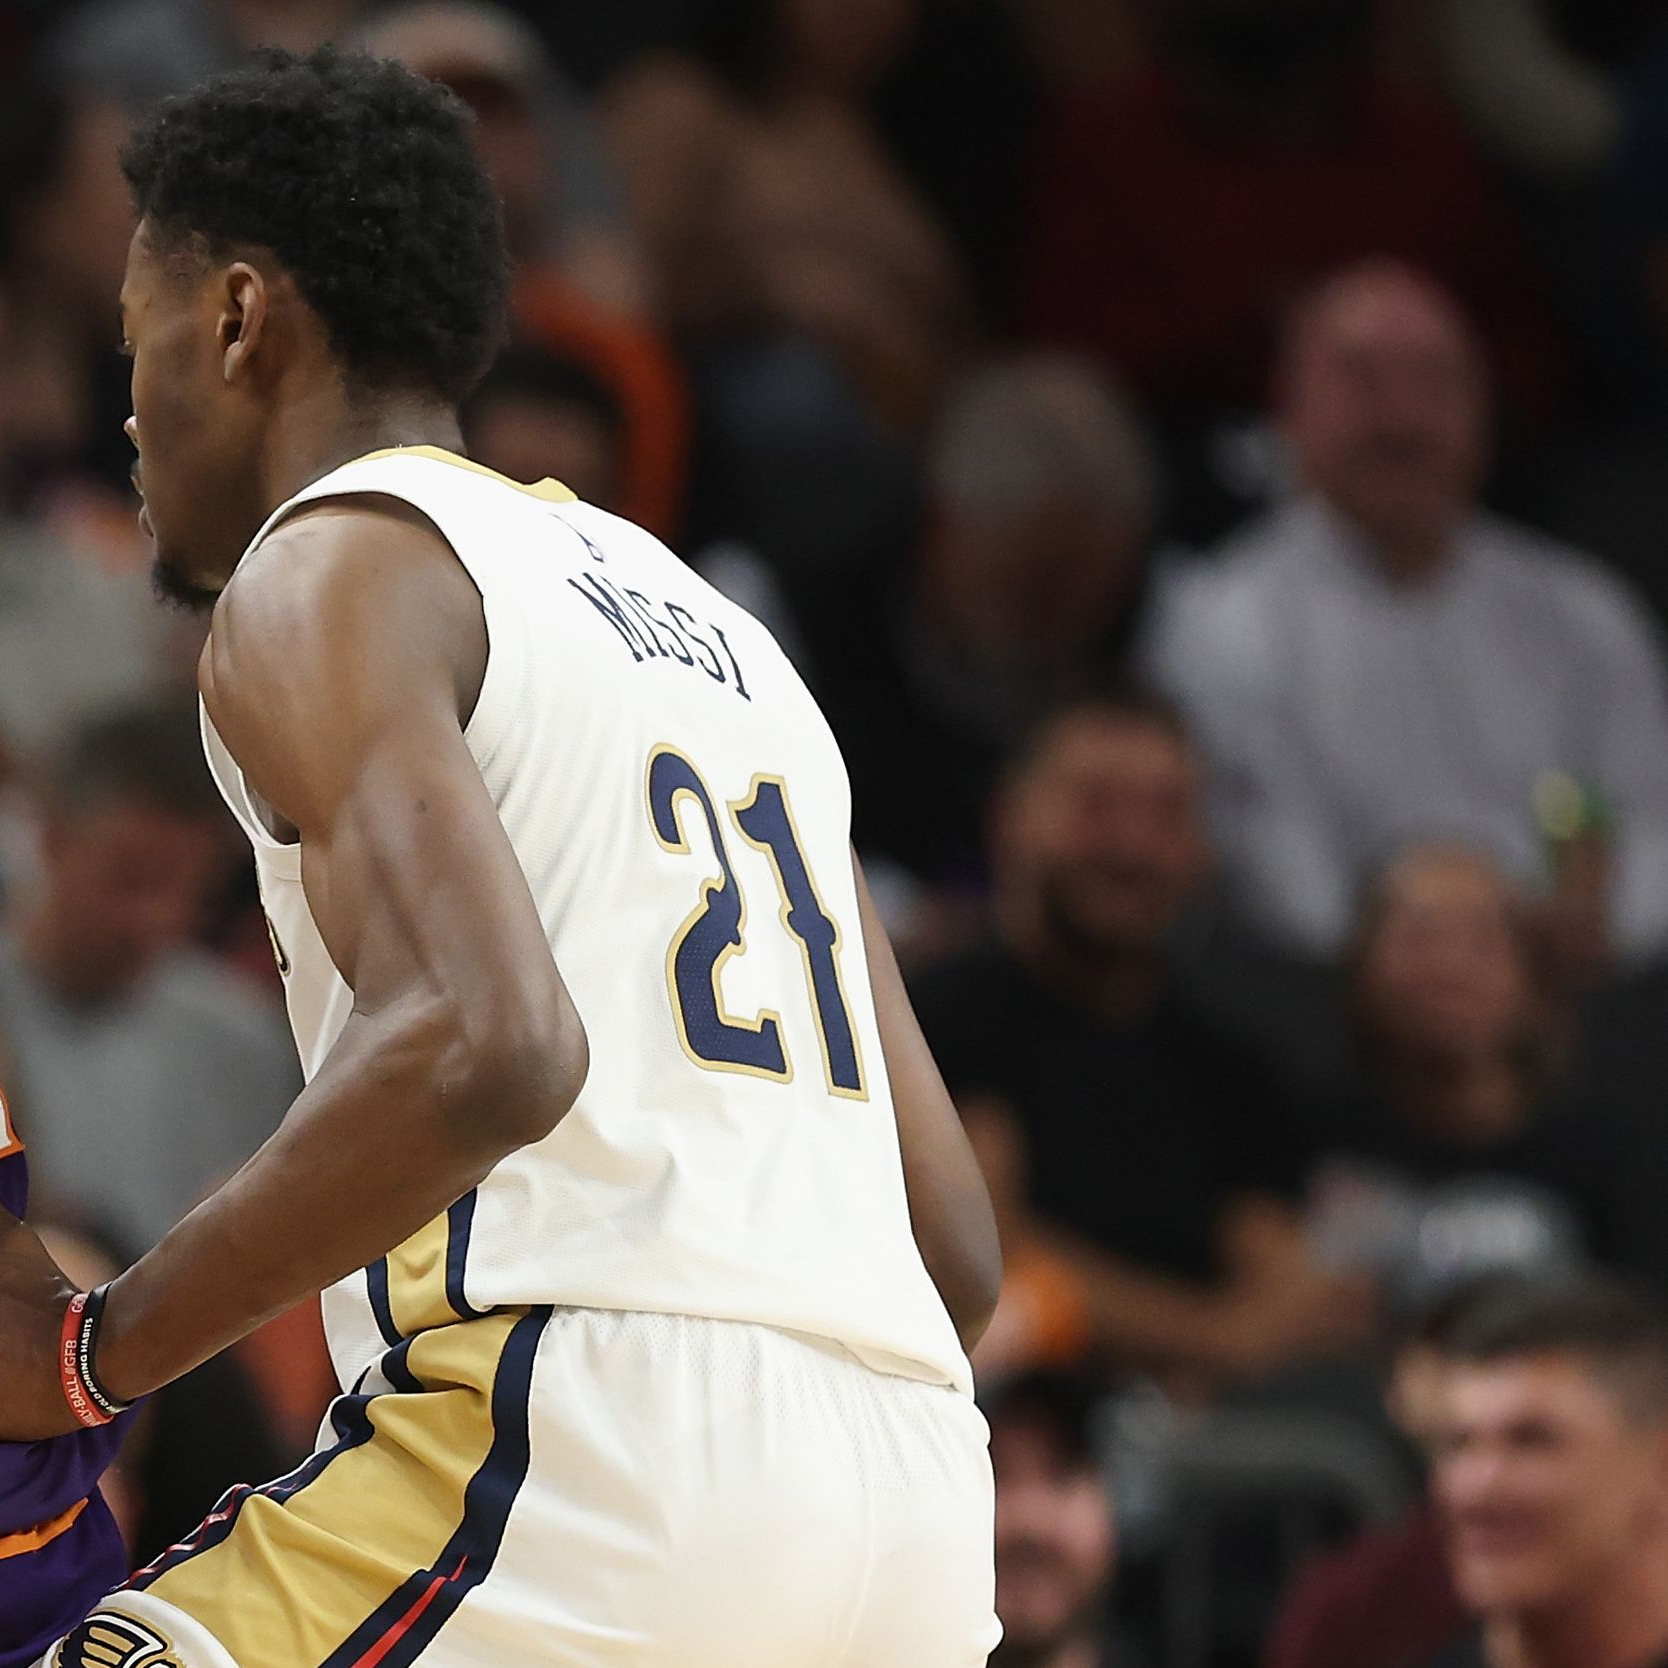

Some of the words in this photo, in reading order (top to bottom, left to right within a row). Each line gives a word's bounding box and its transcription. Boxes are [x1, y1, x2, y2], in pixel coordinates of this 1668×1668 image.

[566, 571, 752, 702] MISSI
[644, 742, 870, 1102] 21
[79, 1316, 93, 1353] HABITS
[79, 1353, 98, 1393] BORING
